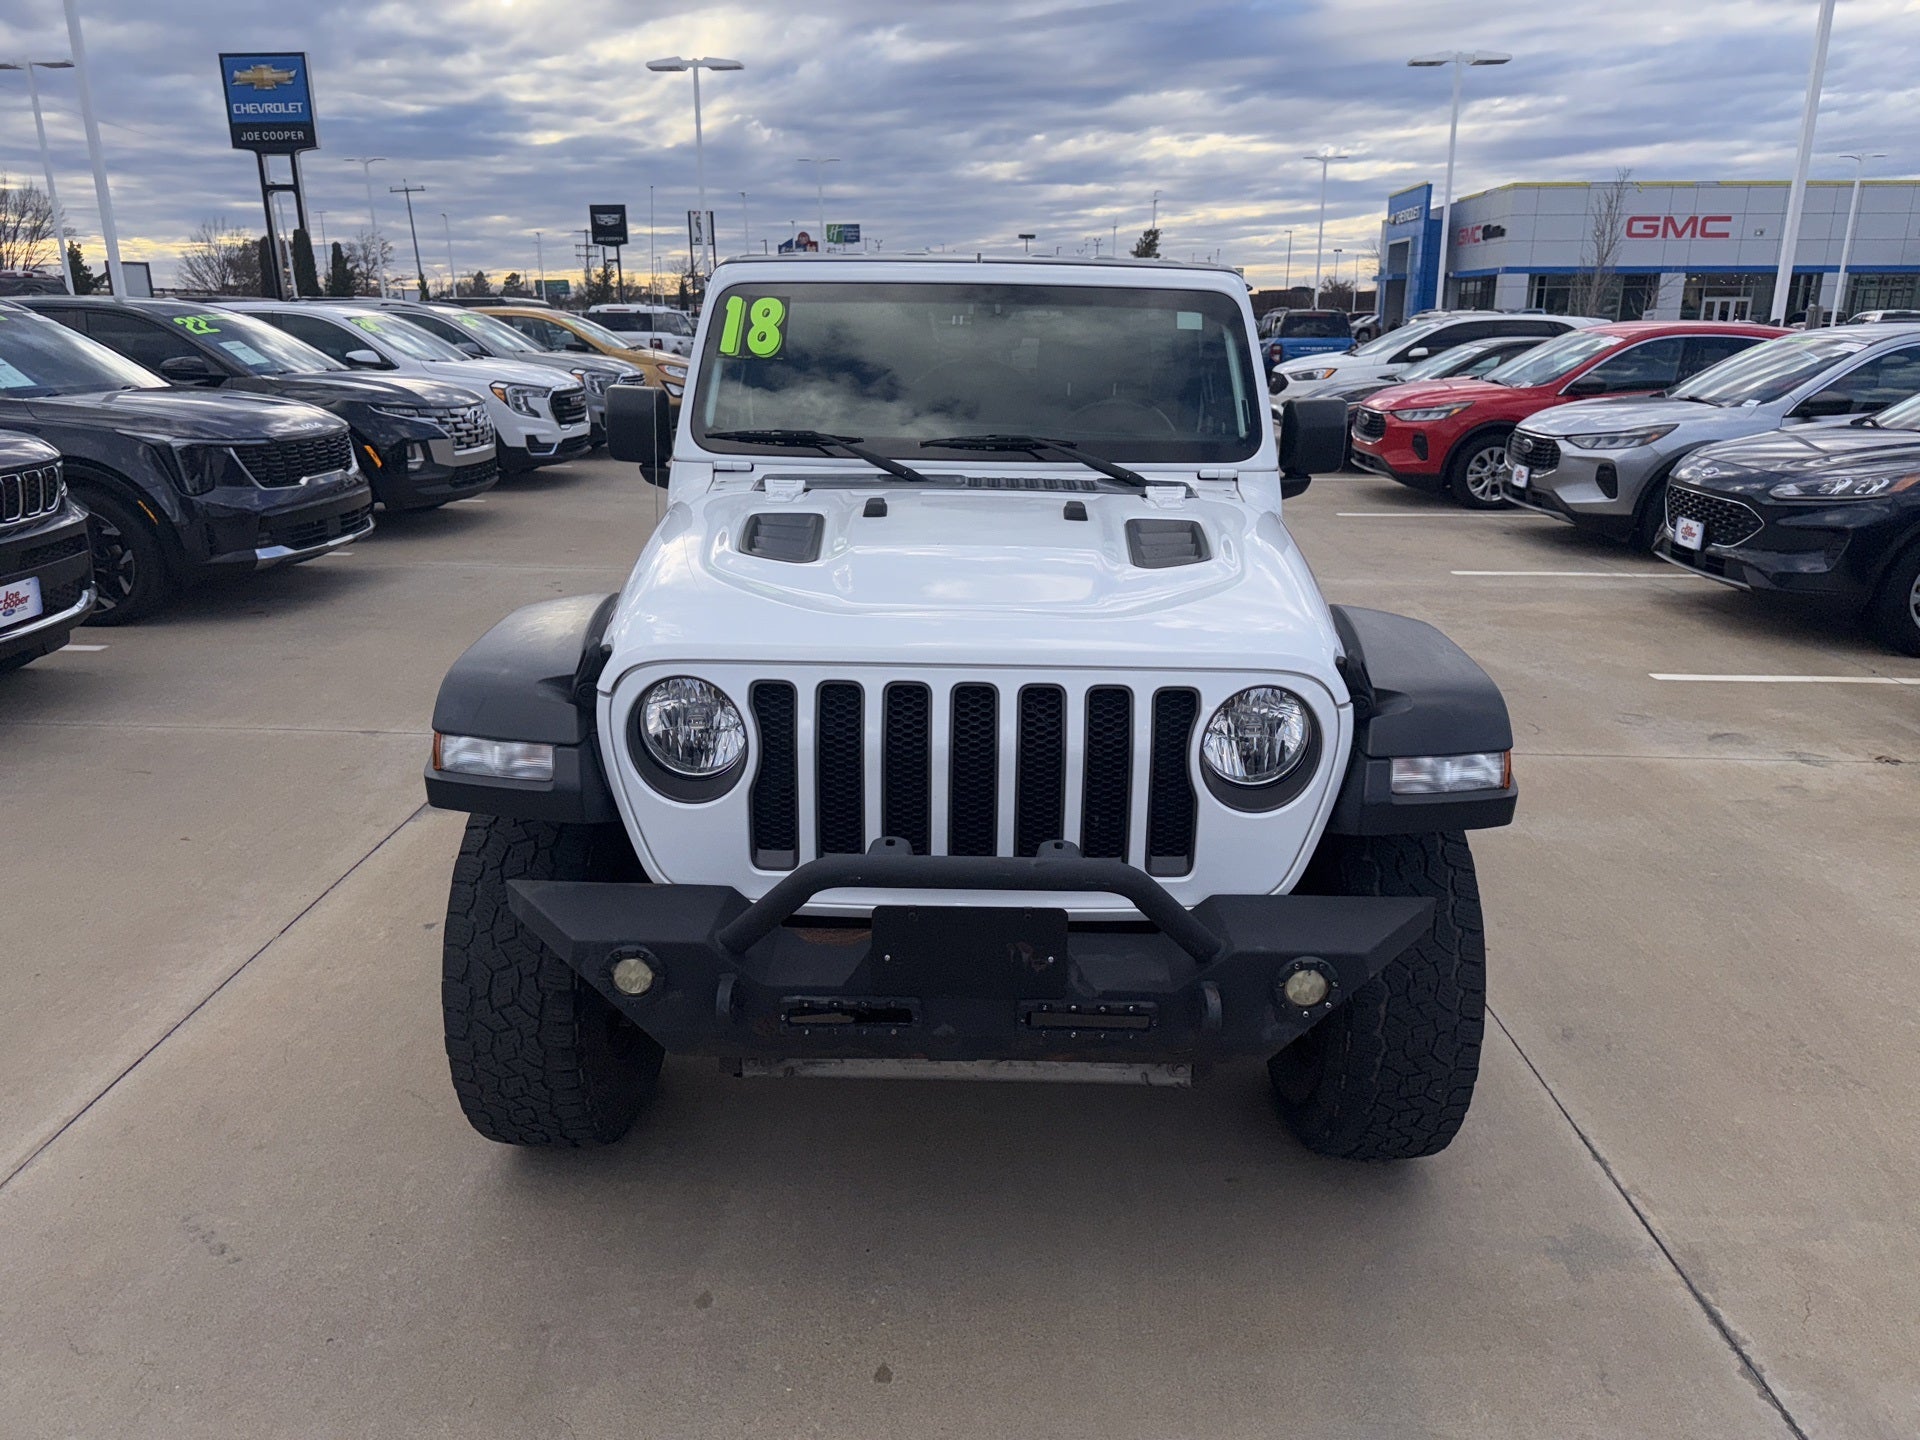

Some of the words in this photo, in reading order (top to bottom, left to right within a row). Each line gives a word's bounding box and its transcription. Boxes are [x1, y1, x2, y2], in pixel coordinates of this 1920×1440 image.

[232, 102, 303, 114] CHEVROLET
[241, 131, 260, 141] JOE
[262, 130, 304, 141] COOPER
[1457, 225, 1482, 246] GMC
[1626, 215, 1732, 239] GMC
[173, 316, 221, 335] 22
[719, 295, 785, 358] 18
[3, 590, 20, 603] Joe
